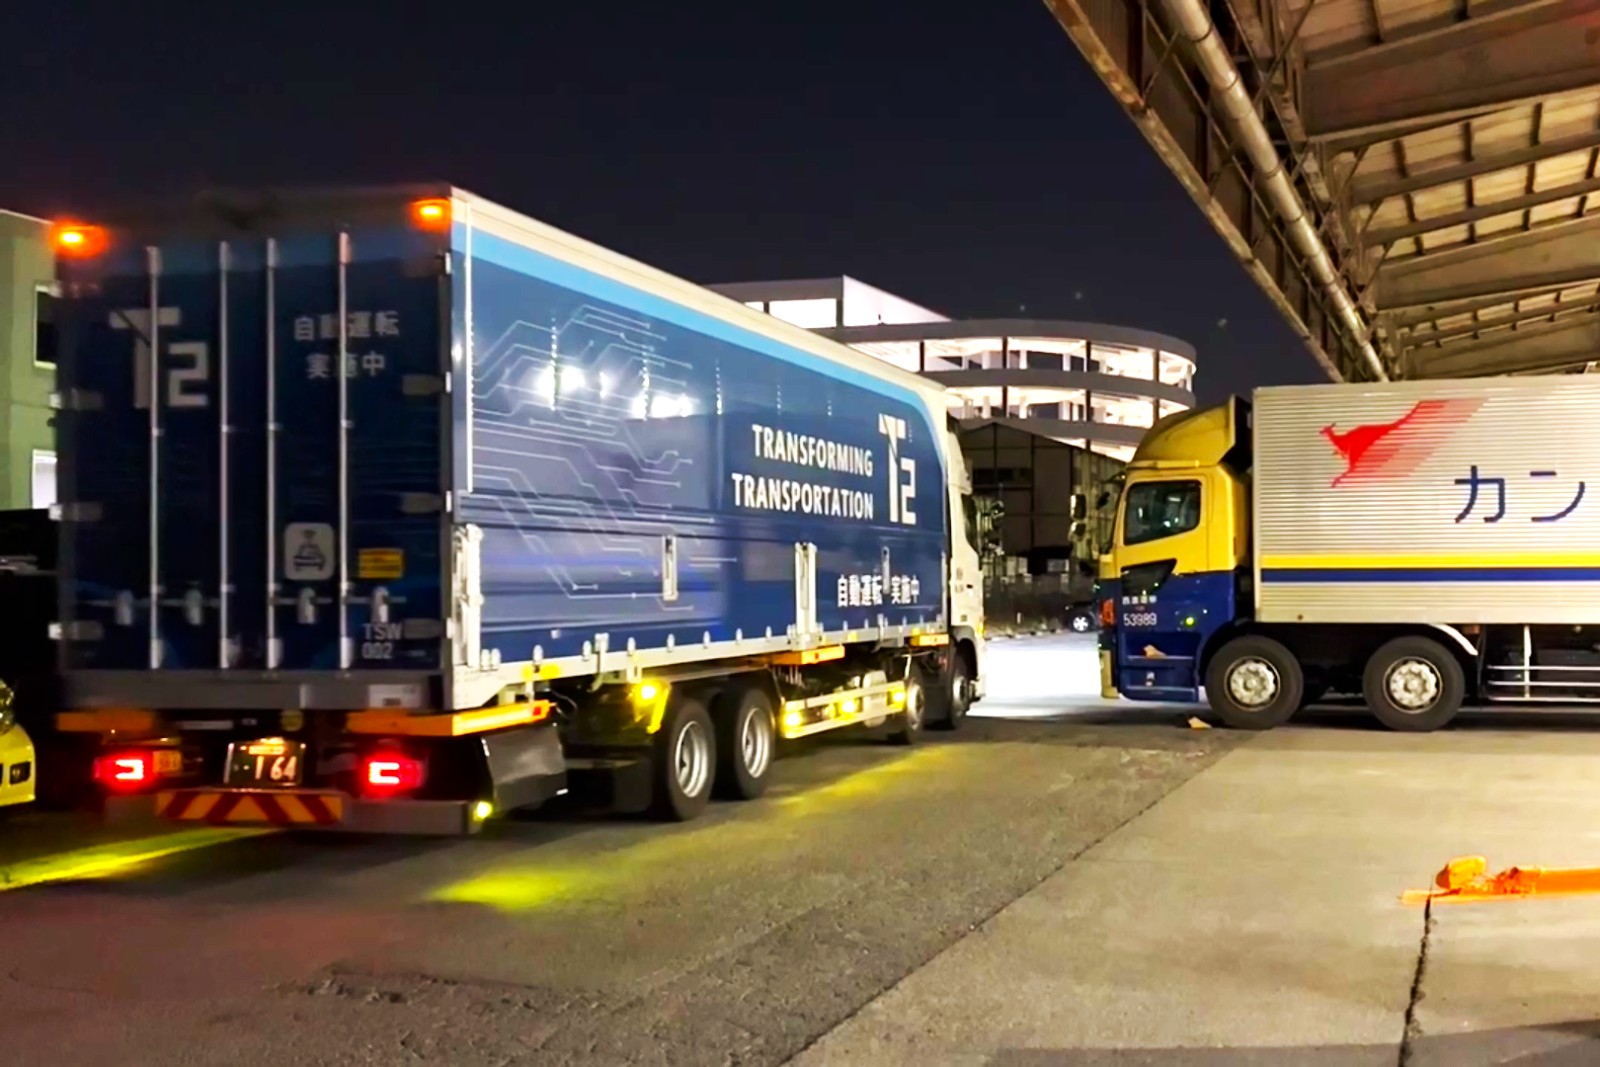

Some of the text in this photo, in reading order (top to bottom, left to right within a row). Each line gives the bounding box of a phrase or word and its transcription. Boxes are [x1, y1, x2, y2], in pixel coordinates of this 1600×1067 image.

[752, 424, 873, 477] TRANSFORMING
[878, 413, 917, 526] T2
[731, 472, 874, 520] TRANSPORTATION
[1454, 464, 1586, 524] カン
